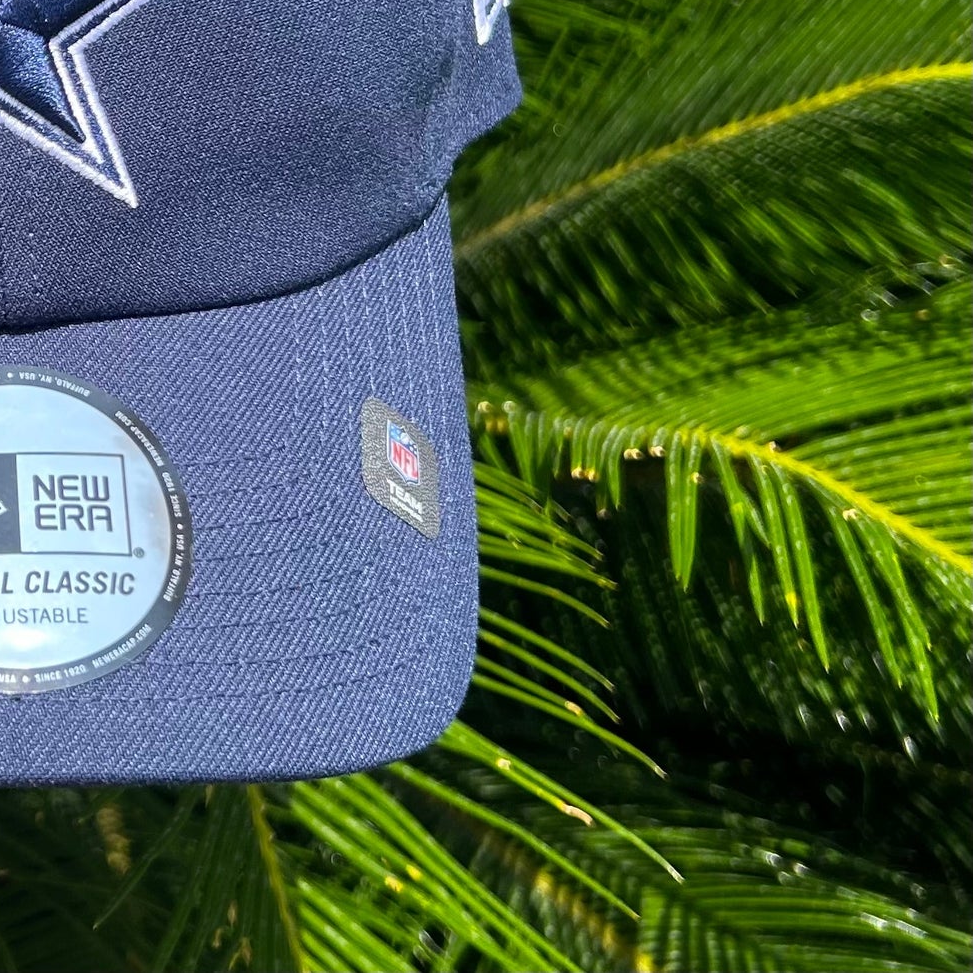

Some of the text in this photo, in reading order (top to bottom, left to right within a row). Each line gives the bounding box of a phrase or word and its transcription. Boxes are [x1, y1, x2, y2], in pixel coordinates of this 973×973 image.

[19, 372, 35, 380] USA
[114, 410, 165, 467] NEWERACAP.COM
[392, 442, 419, 478] NFL
[32, 474, 110, 501] NEW
[162, 472, 175, 492] 1920
[171, 494, 182, 518] SINCE
[387, 479, 423, 513] TEAM
[34, 505, 113, 532] ERA
[176, 534, 184, 550] USA
[24, 571, 135, 596] CLASSIC
[34, 672, 62, 682] SINCE
[64, 666, 86, 677] 1920
[92, 623, 152, 668] NEWERACAP.COM
